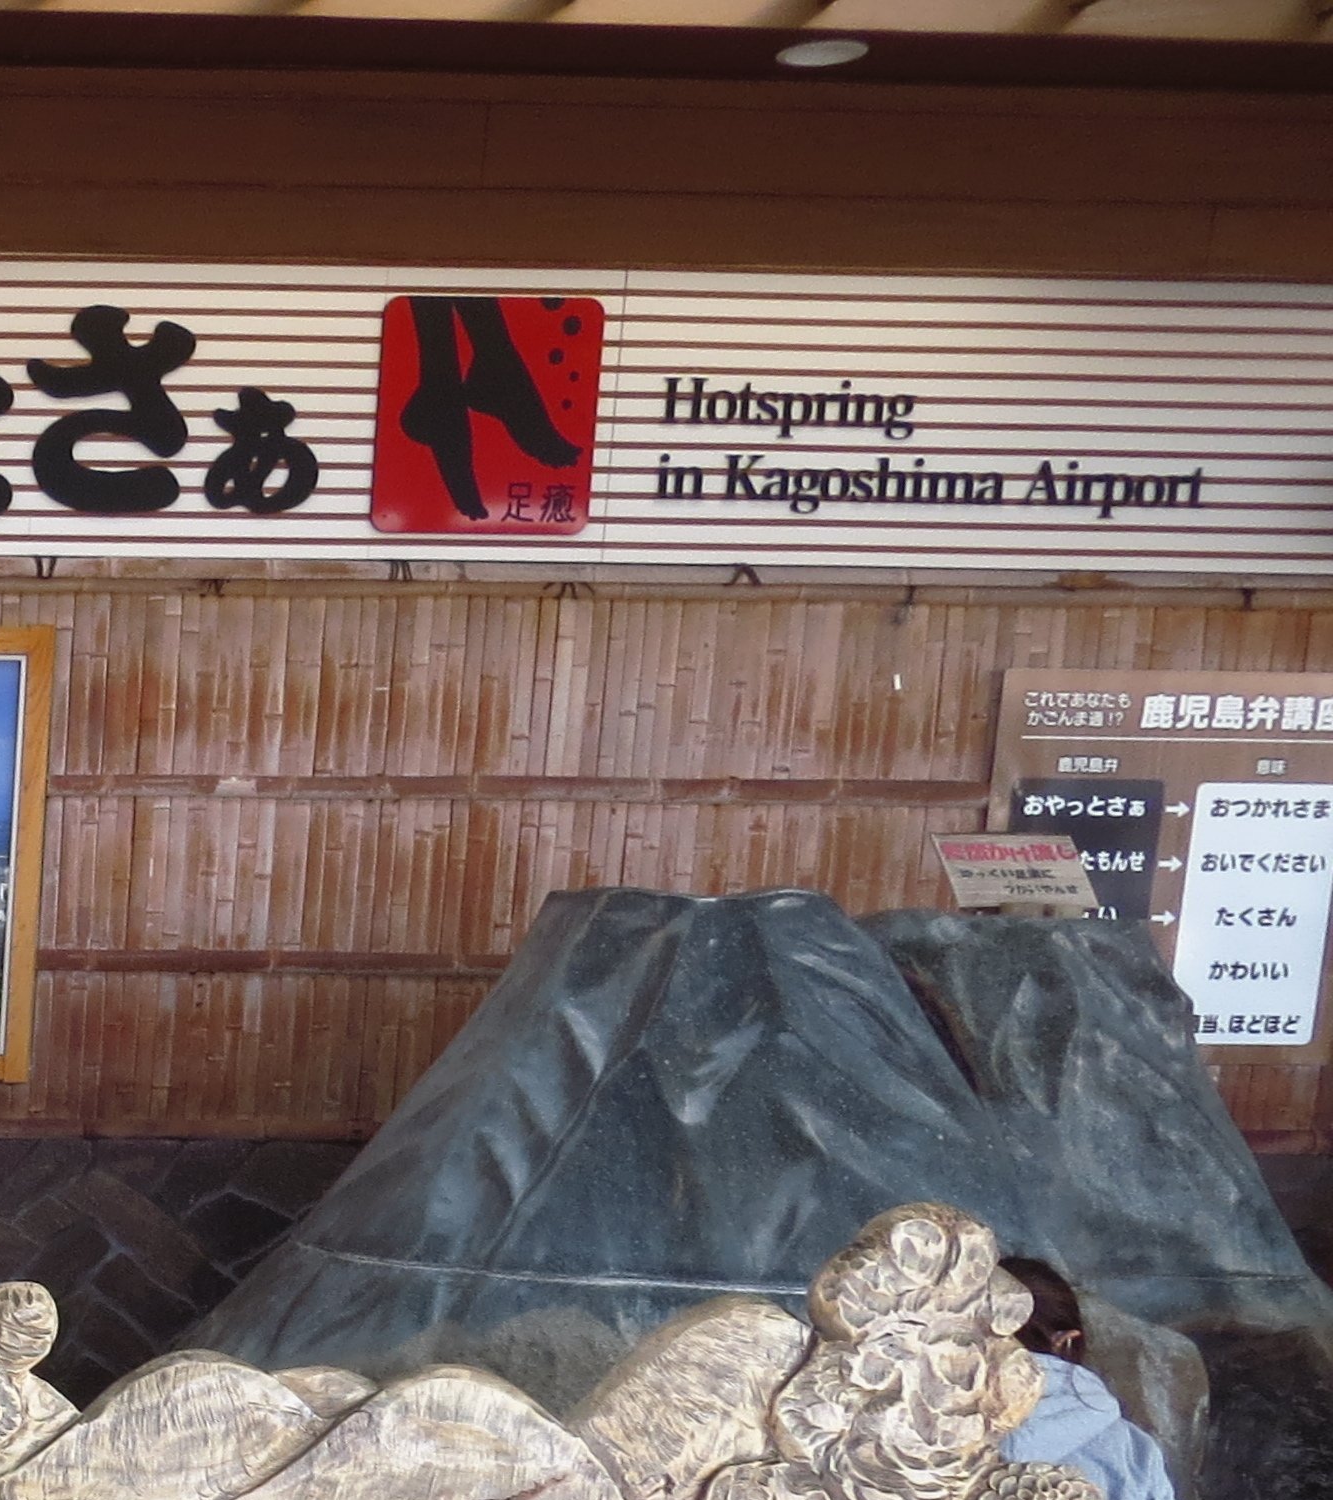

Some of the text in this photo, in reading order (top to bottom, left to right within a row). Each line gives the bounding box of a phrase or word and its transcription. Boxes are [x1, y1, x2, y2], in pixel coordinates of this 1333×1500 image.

[662, 376, 916, 441] Hotspring
[656, 453, 1205, 520] in Kagoshima Airport
[500, 481, 577, 523] 足癒
[1023, 692, 1132, 709] これであなたも
[1057, 757, 1119, 774] 鹿児島弁
[1022, 795, 1146, 818] おやっとさぁ
[1209, 798, 1332, 819] おつかれさま
[1199, 852, 1327, 873] おいでください
[1214, 907, 1297, 927] たくさん
[1207, 961, 1290, 981] かわいい
